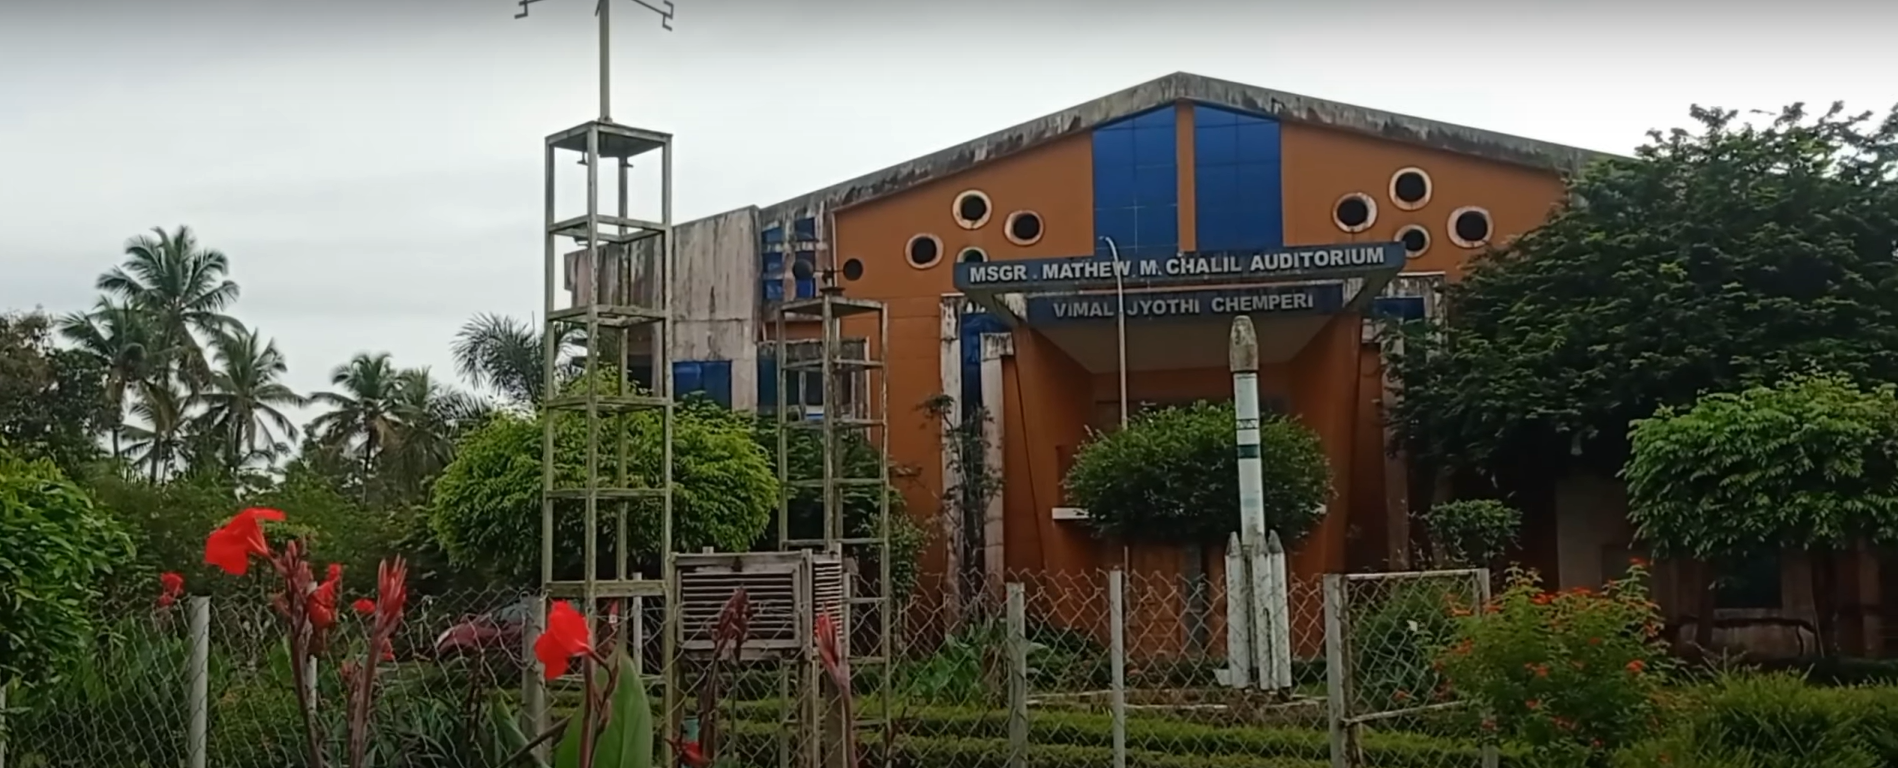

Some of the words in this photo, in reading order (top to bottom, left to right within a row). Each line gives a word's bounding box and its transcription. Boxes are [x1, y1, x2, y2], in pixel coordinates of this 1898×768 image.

[970, 265, 1027, 282] MSGR
[1166, 257, 1242, 274] CHALIL
[1250, 247, 1384, 271] AUDITORIUM
[1054, 302, 1114, 318] VIMAL
[1127, 299, 1200, 316] JYOTHI
[1211, 293, 1313, 312] CHEMPERI
